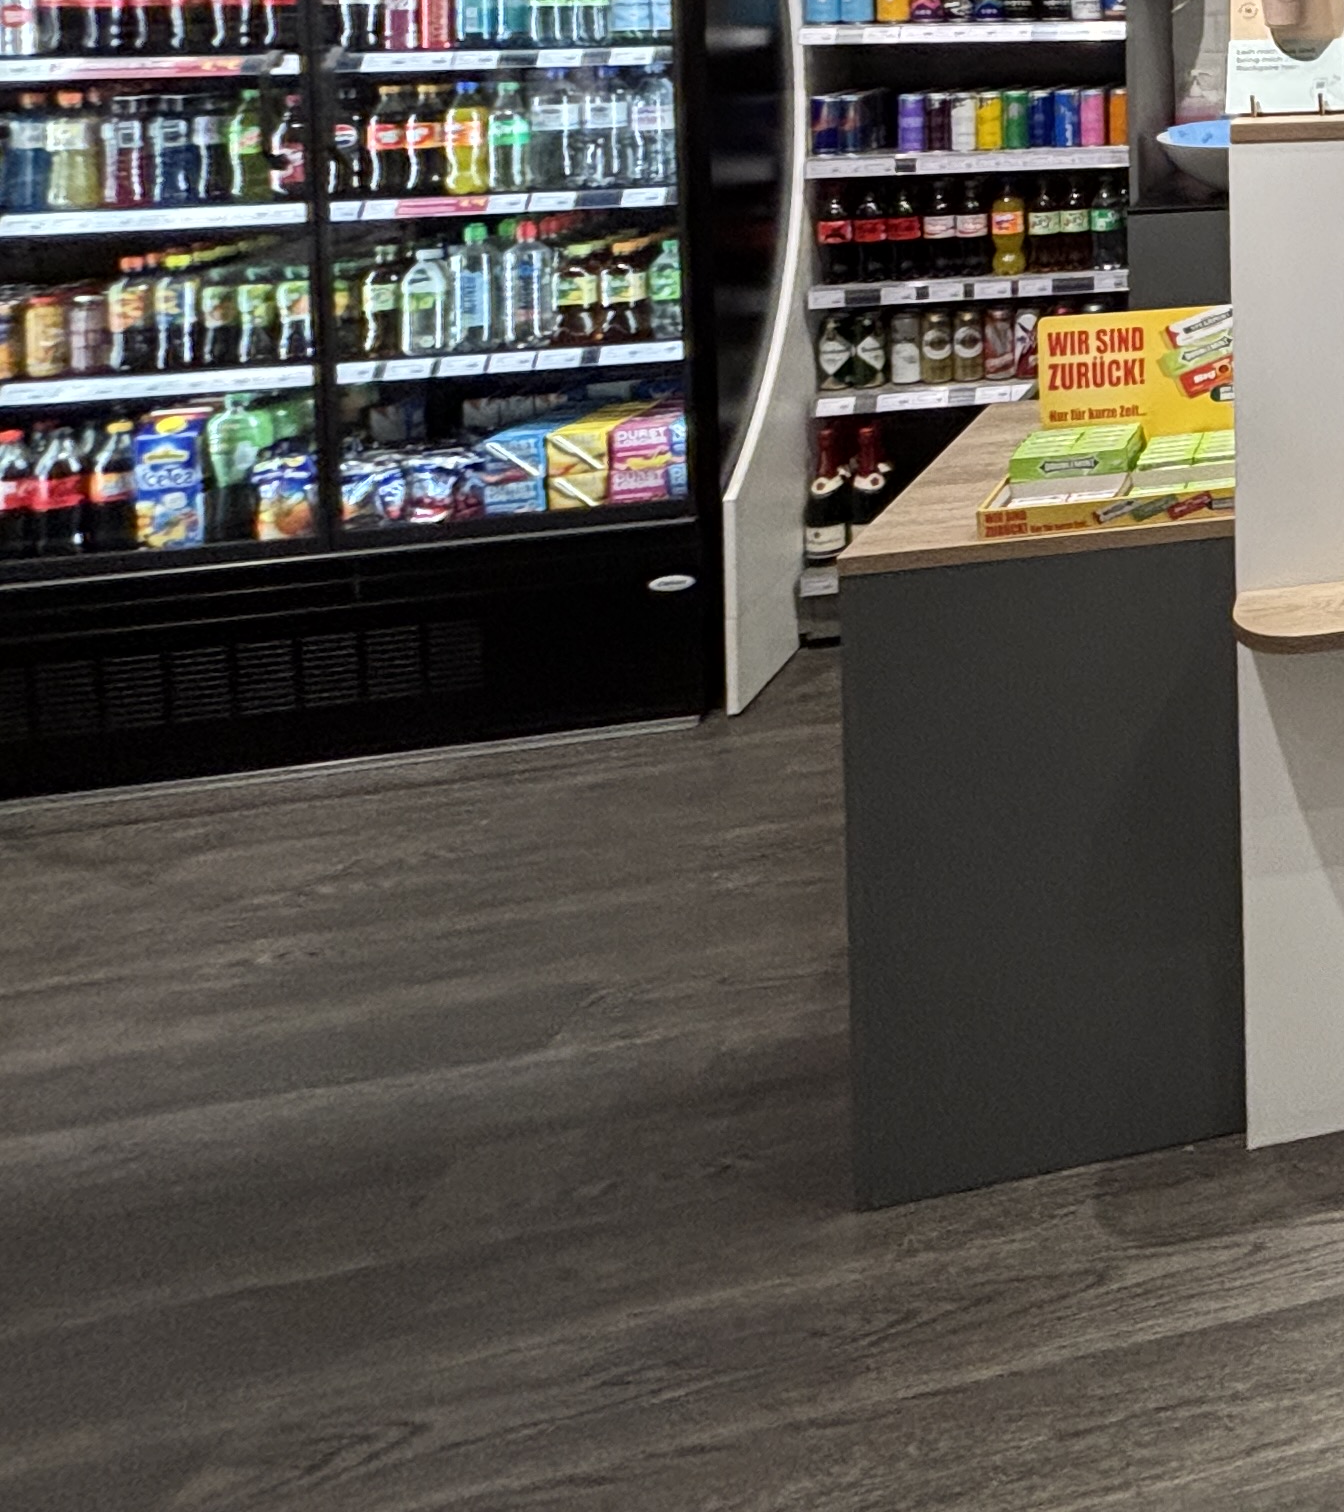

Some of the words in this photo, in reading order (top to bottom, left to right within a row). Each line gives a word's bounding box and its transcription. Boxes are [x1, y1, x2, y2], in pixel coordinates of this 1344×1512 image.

[1048, 330, 1090, 357] WIR
[1096, 327, 1144, 355] SIND
[1048, 356, 1145, 391] ZURÜCK!
[1071, 408, 1085, 421] für
[1088, 407, 1117, 420] kurze
